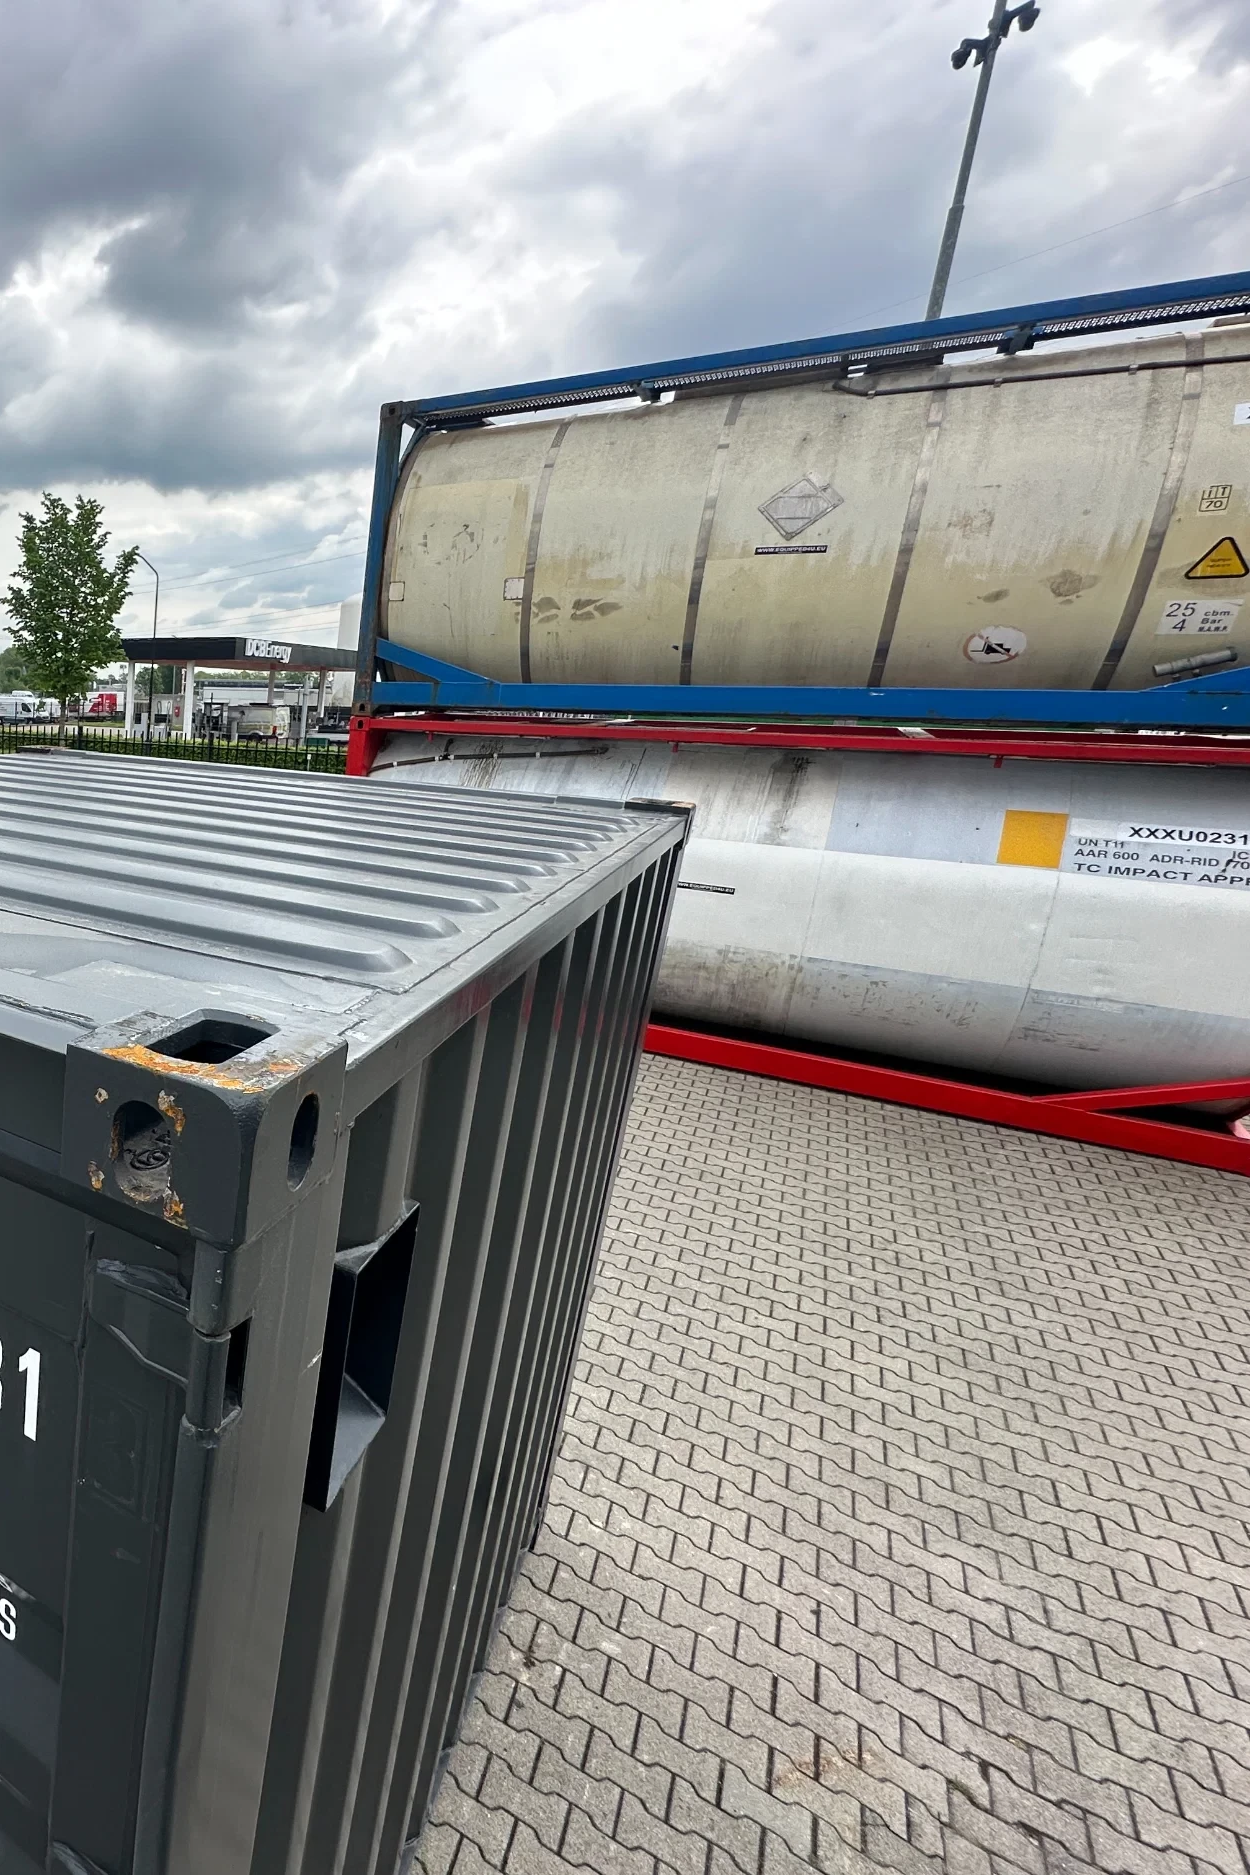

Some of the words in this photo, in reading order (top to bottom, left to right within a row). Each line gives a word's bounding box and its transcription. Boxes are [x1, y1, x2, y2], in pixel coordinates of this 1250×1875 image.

[1205, 500, 1223, 509] 70
[1166, 602, 1198, 618] 25
[1172, 618, 1187, 633] 4
[1078, 838, 1099, 848] UN
[1103, 839, 1125, 849] T11
[1074, 848, 1108, 859] AAR
[1113, 850, 1140, 861] 600
[1149, 853, 1220, 867] ADR-RID
[1073, 862, 1101, 874] TC
[1107, 865, 1193, 881] IMPACT
